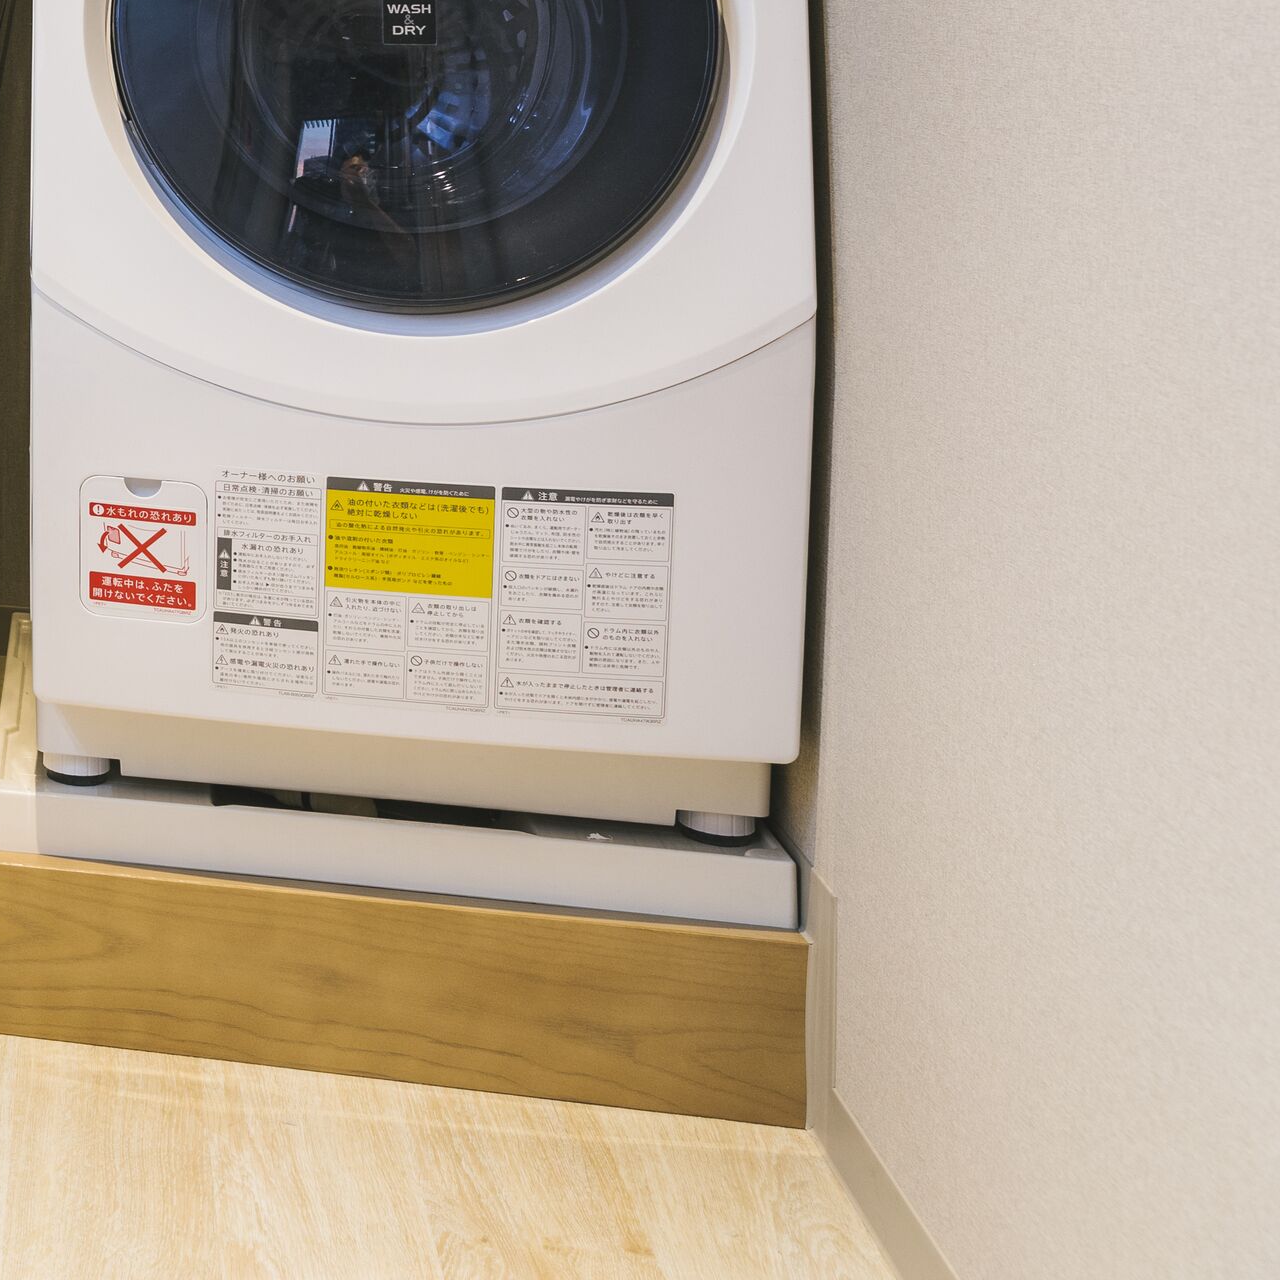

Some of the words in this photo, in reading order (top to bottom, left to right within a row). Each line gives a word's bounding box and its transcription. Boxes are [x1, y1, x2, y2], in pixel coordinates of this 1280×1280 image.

[387, 3, 431, 14] WASH
[404, 14, 415, 25] &
[392, 25, 426, 35] DRY
[221, 470, 315, 484] オーナー様へのお願い
[223, 483, 314, 497] 日常点検・清掃のお願い
[373, 482, 392, 492] 警告
[538, 491, 558, 501] 注意
[347, 499, 489, 514] 油の付いた衣類などは(洗濯後でも)
[106, 505, 192, 524] 水もれの恐れあり
[347, 508, 418, 520] 絶対に乾燥しない
[223, 530, 311, 544] 排水フィルターのお手入れ
[241, 543, 304, 555] 水漏れの恐れあり
[605, 572, 656, 580] やけどに注意する
[101, 575, 183, 593] 運転中は、ふたを
[92, 587, 192, 608] 開けないでください。
[263, 617, 282, 627] 警告
[230, 627, 280, 638] 発火の恐れあり
[602, 634, 654, 642] のものを入れない
[229, 658, 315, 673] 感電や漏電火災の恐れあり
